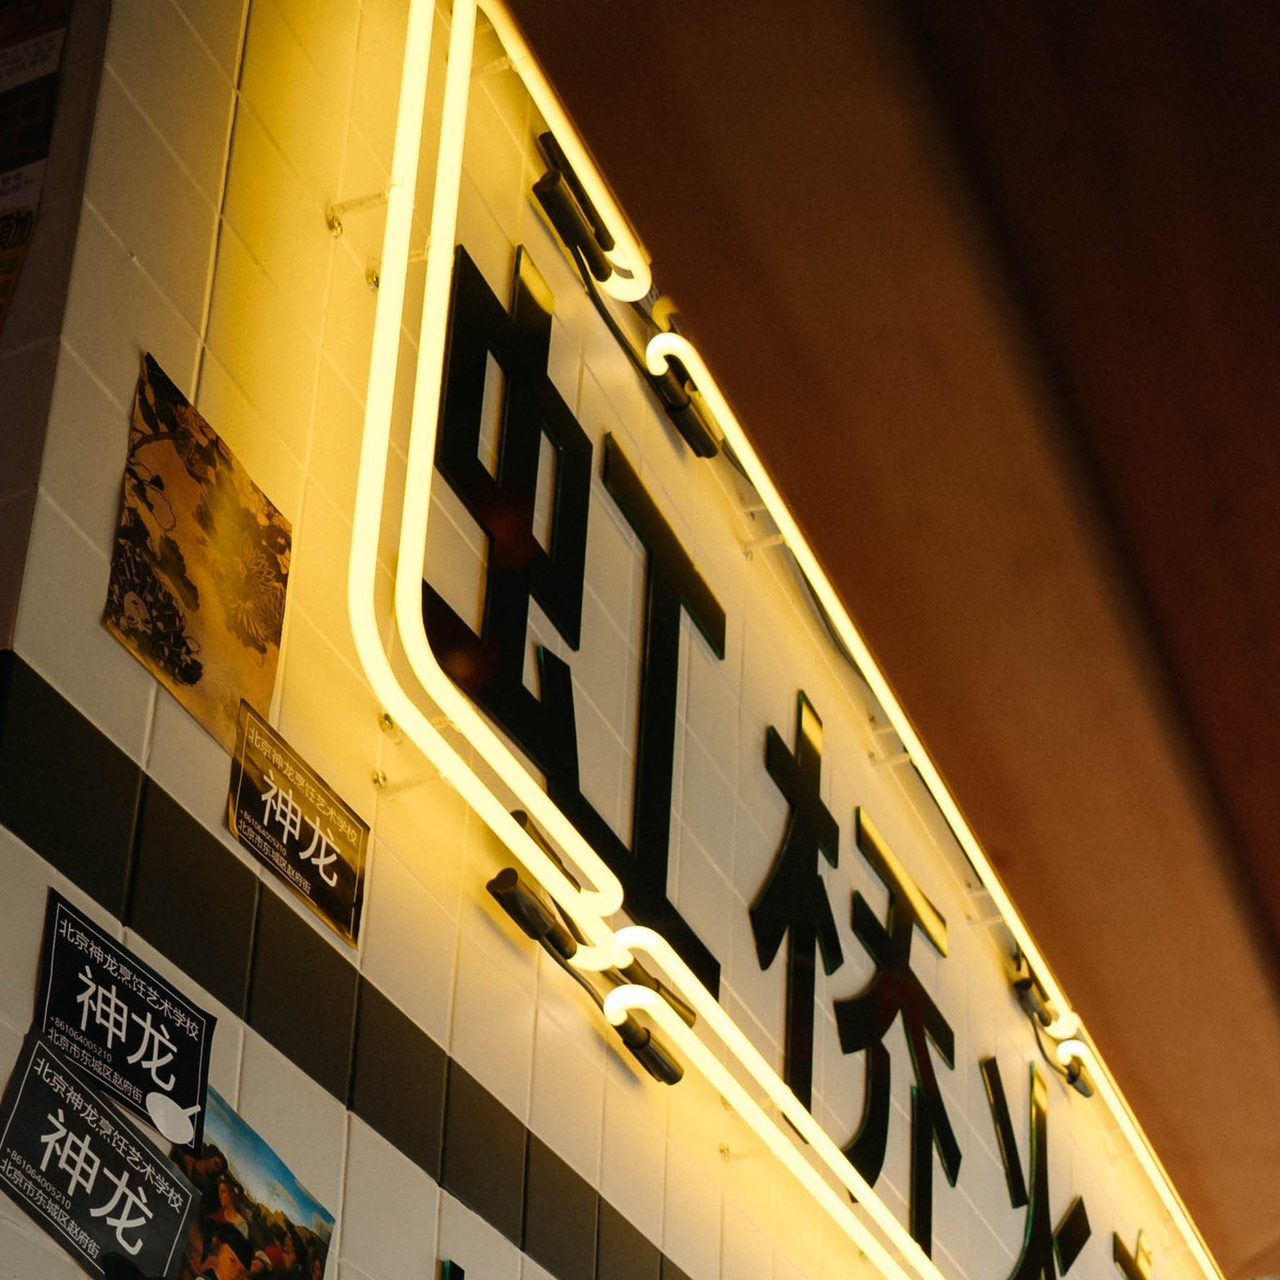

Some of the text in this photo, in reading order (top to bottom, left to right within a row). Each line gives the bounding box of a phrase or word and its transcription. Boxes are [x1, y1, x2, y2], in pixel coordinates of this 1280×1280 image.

[261, 769, 341, 887] 神龙
[59, 919, 199, 1041] 北京神龙烹饪艺术学校
[76, 965, 177, 1091] 神龙
[33, 1057, 184, 1213] 北京神龙烹饪艺术学校
[40, 1108, 154, 1256] 神龙
